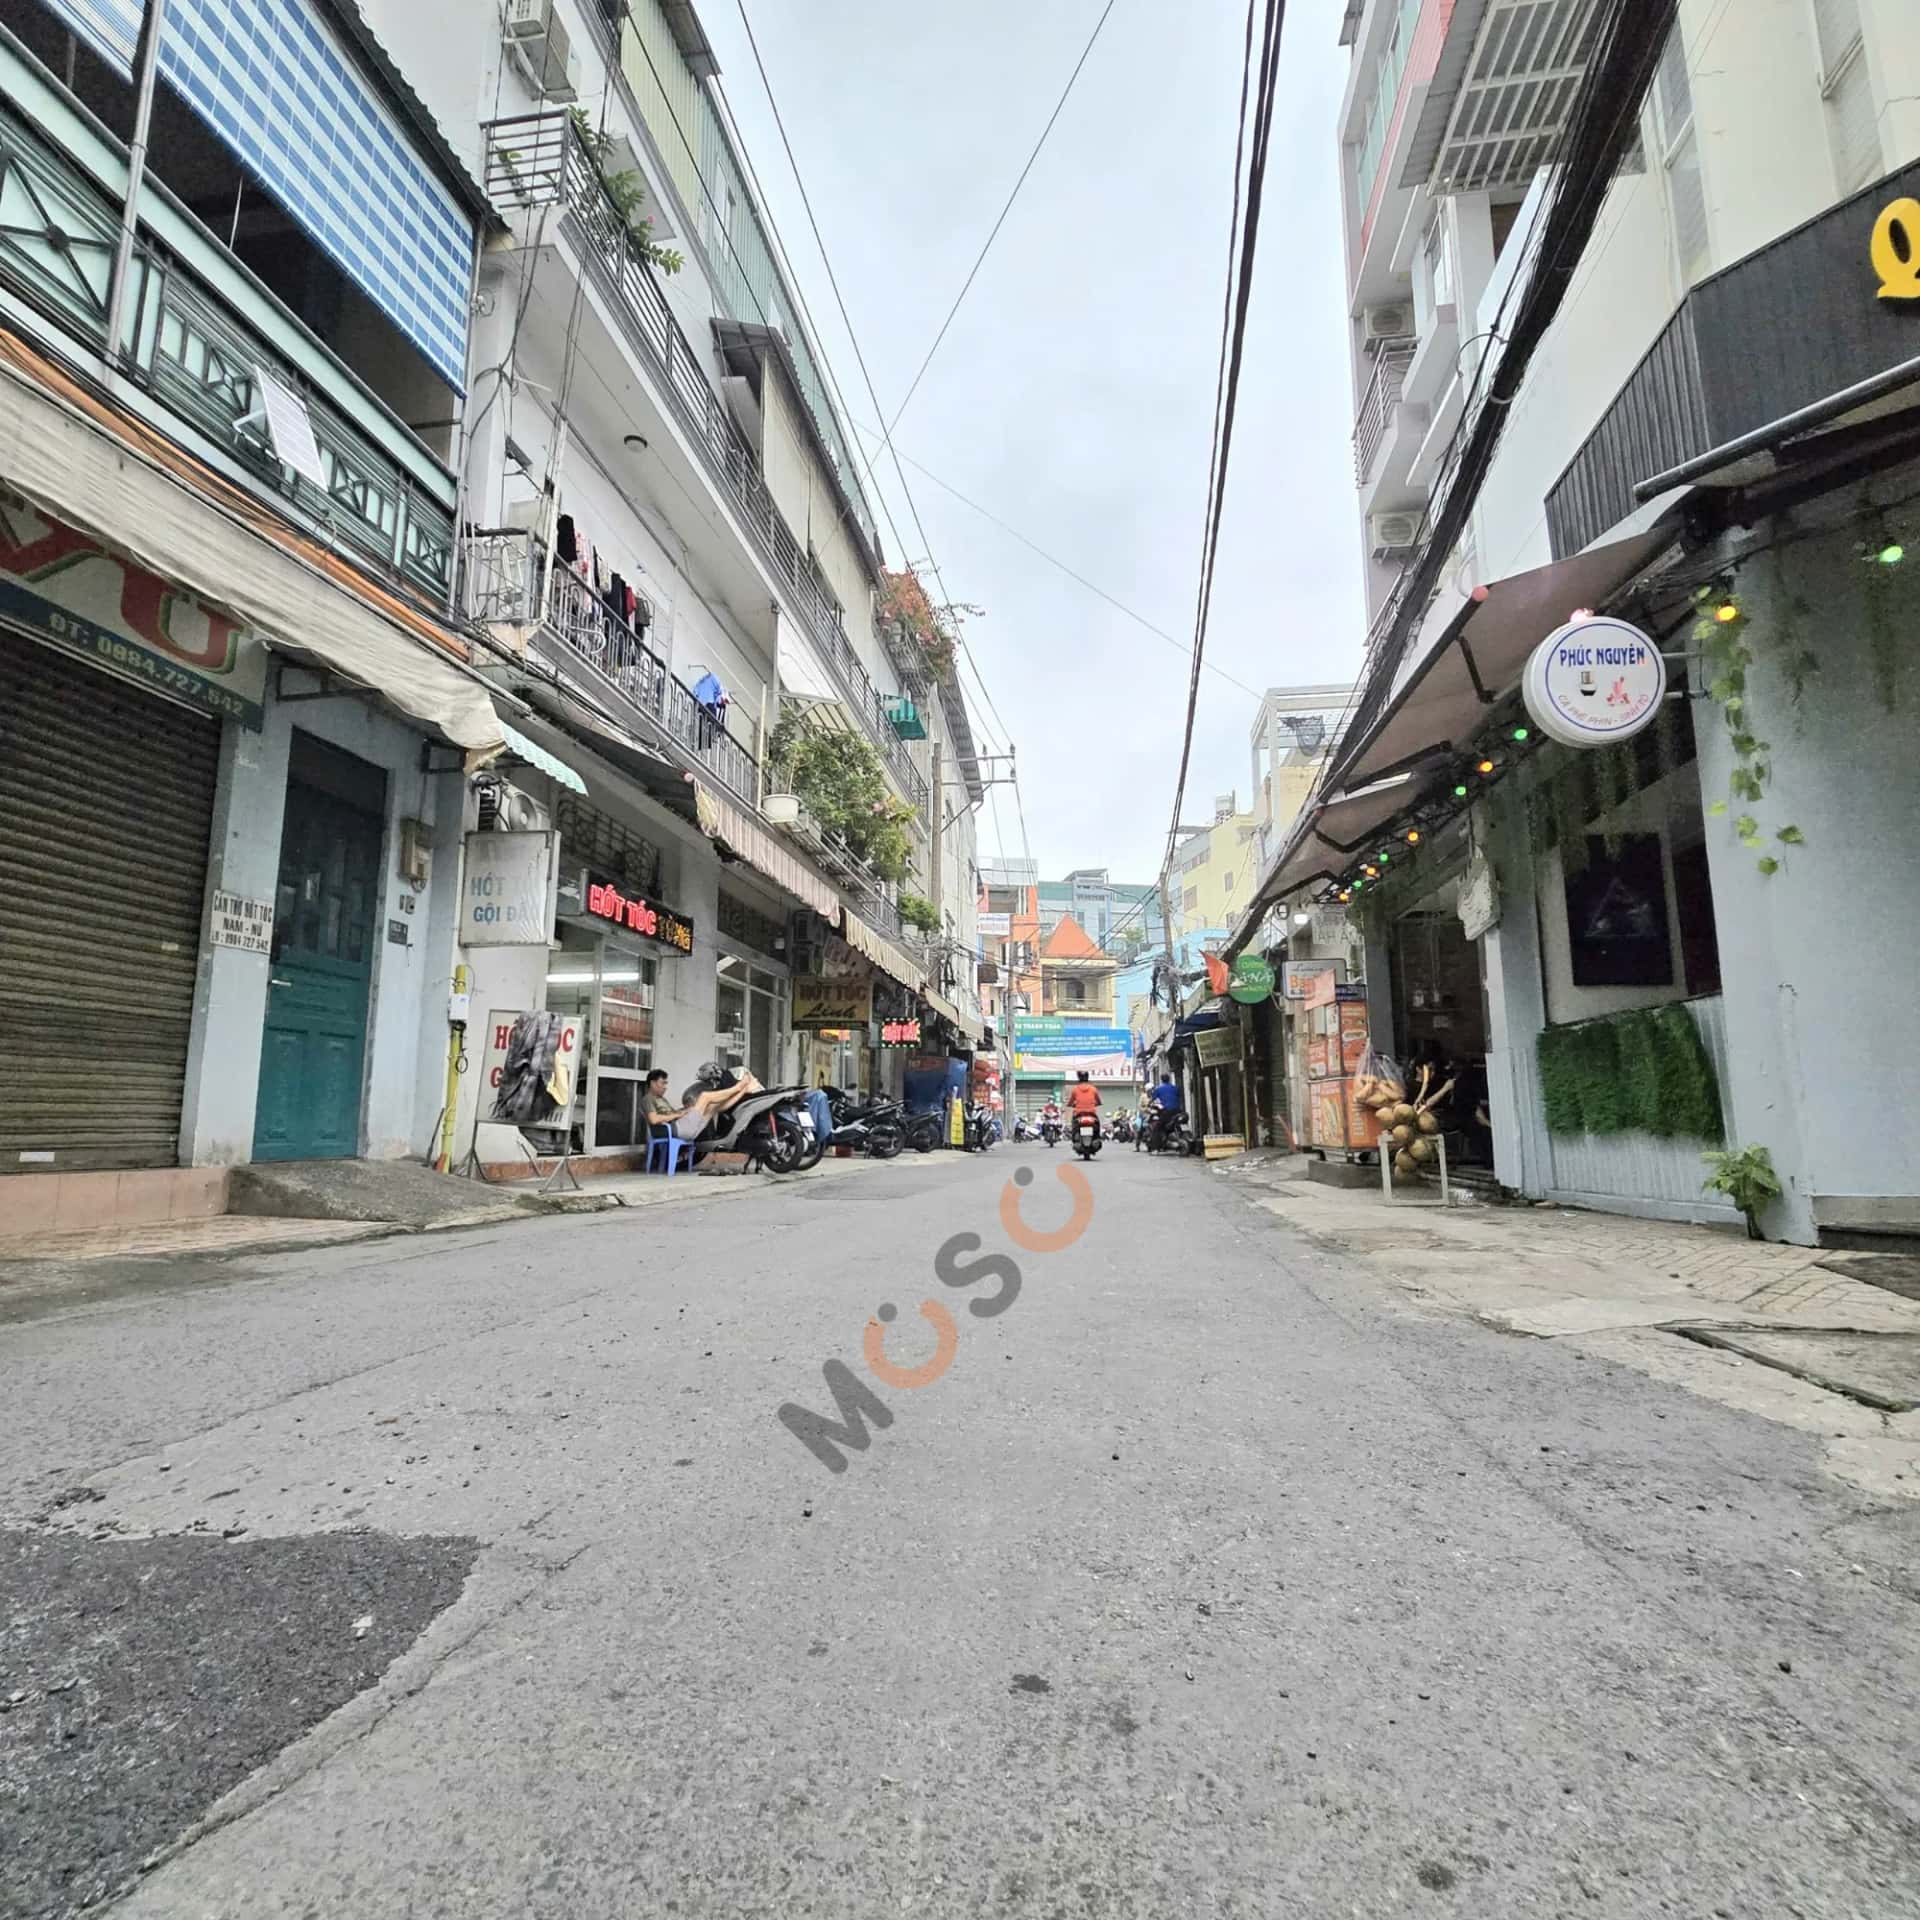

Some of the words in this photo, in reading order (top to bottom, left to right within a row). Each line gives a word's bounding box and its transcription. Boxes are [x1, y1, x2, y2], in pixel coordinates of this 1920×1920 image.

[1560, 643, 1592, 667] PHÚC
[474, 902, 501, 925] GỘI
[589, 884, 626, 922] HỚT
[626, 900, 657, 935] TÓC
[223, 918, 244, 934] NAM
